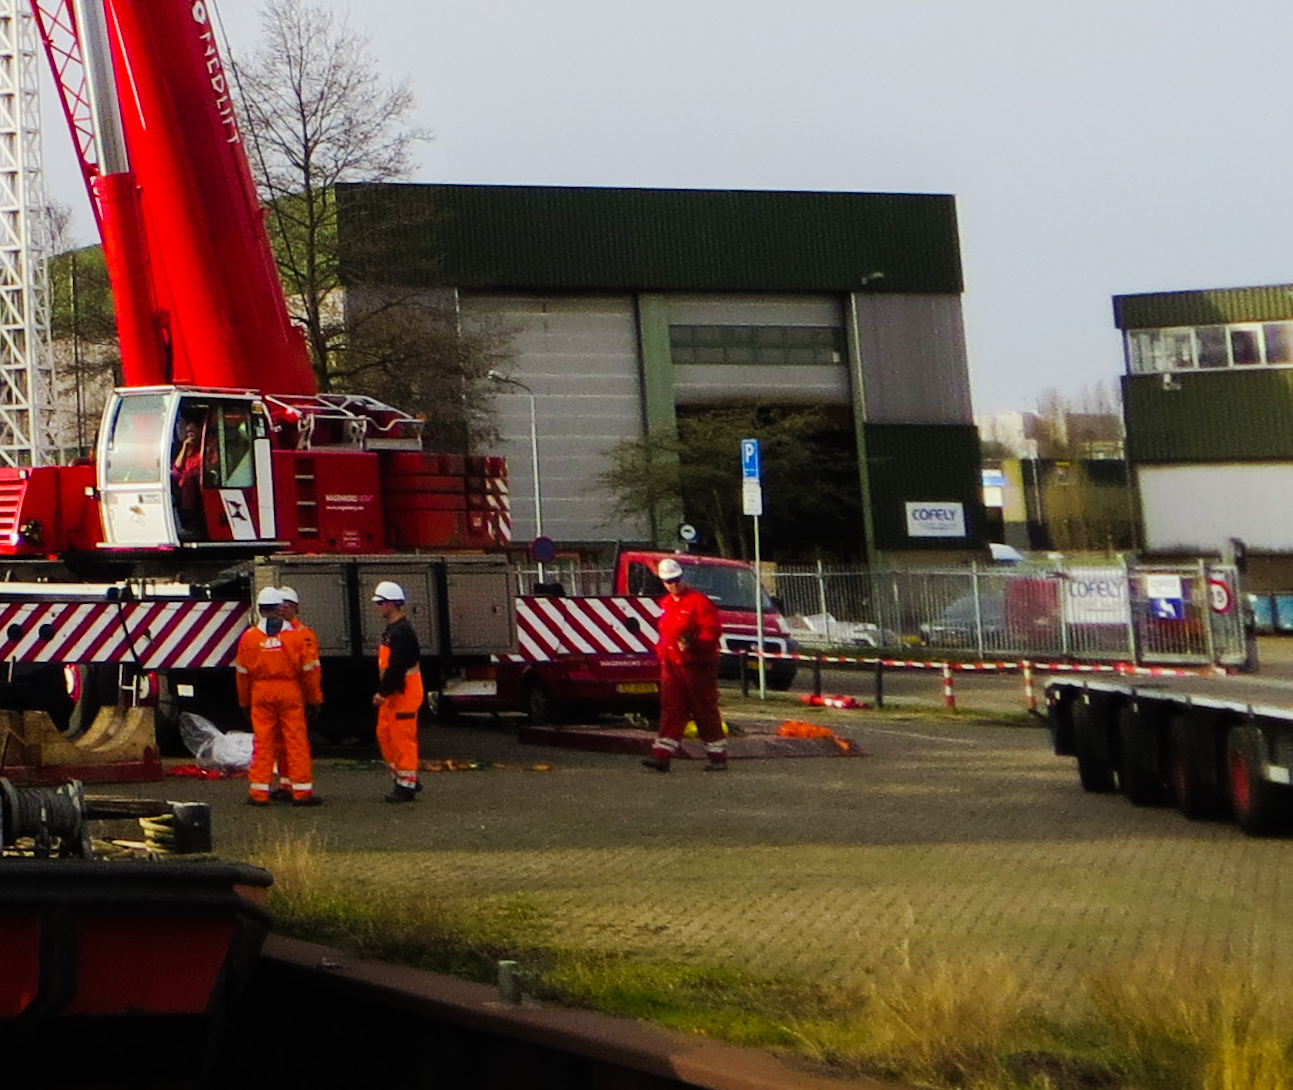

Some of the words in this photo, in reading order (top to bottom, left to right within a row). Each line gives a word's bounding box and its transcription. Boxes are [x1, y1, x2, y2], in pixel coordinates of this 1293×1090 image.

[199, 32, 240, 143] NEDLIFT
[745, 443, 755, 463] P
[913, 508, 956, 521] COFELY
